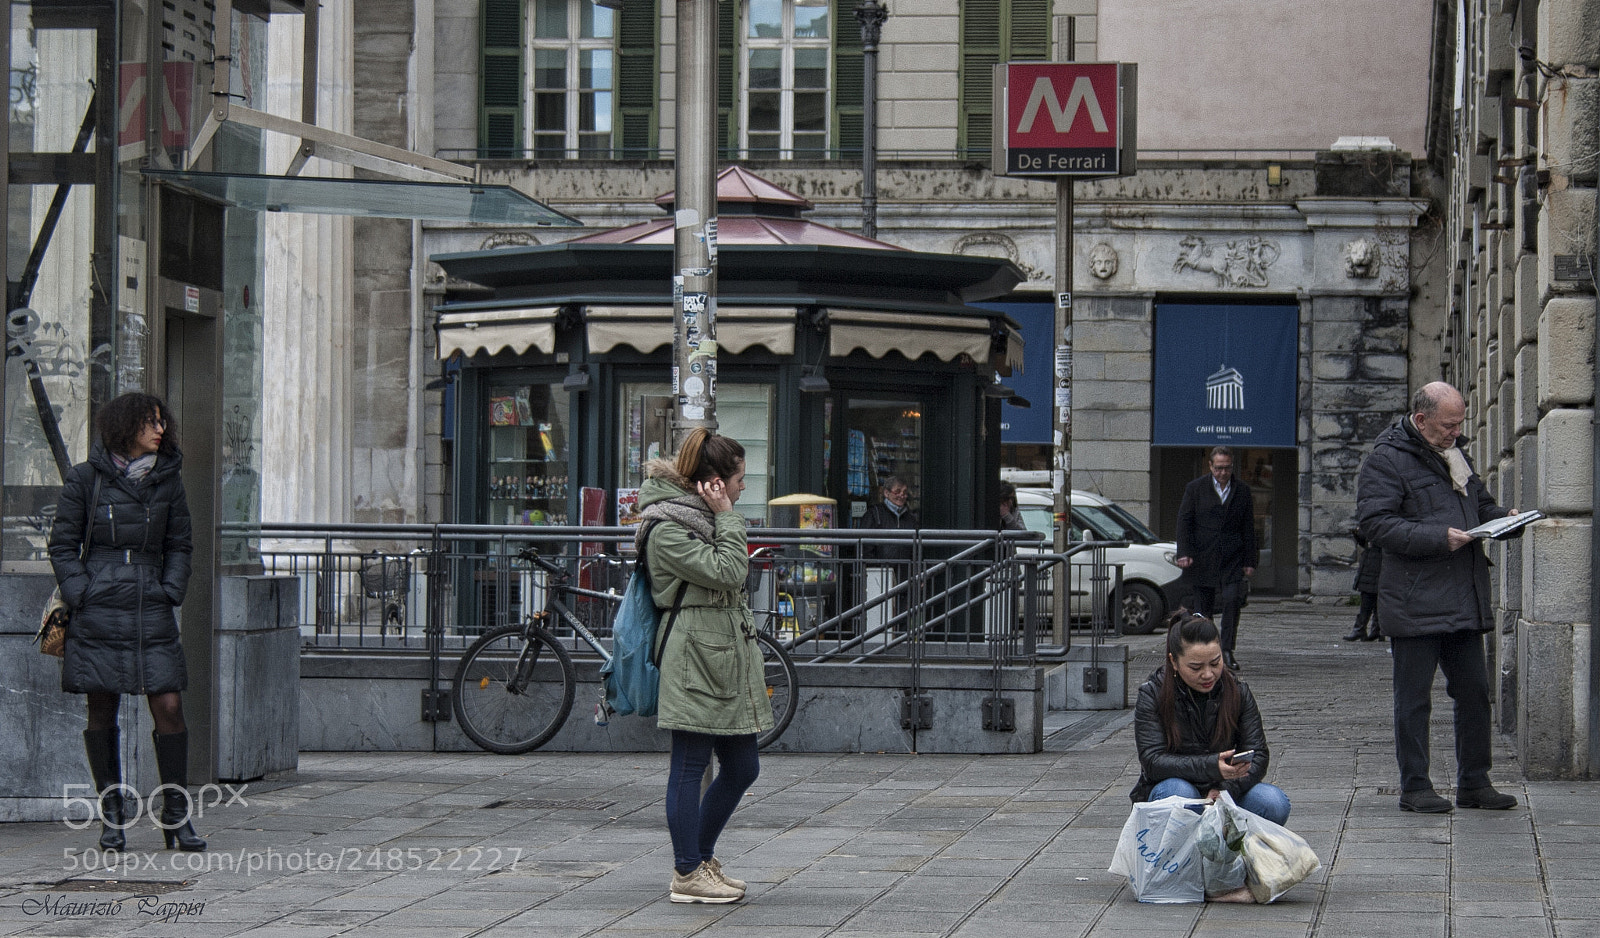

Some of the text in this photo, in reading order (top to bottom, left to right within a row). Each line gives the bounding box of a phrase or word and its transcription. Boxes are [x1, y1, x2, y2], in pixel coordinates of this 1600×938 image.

[1016, 76, 1109, 133] M
[1018, 153, 1106, 169] De Ferrari
